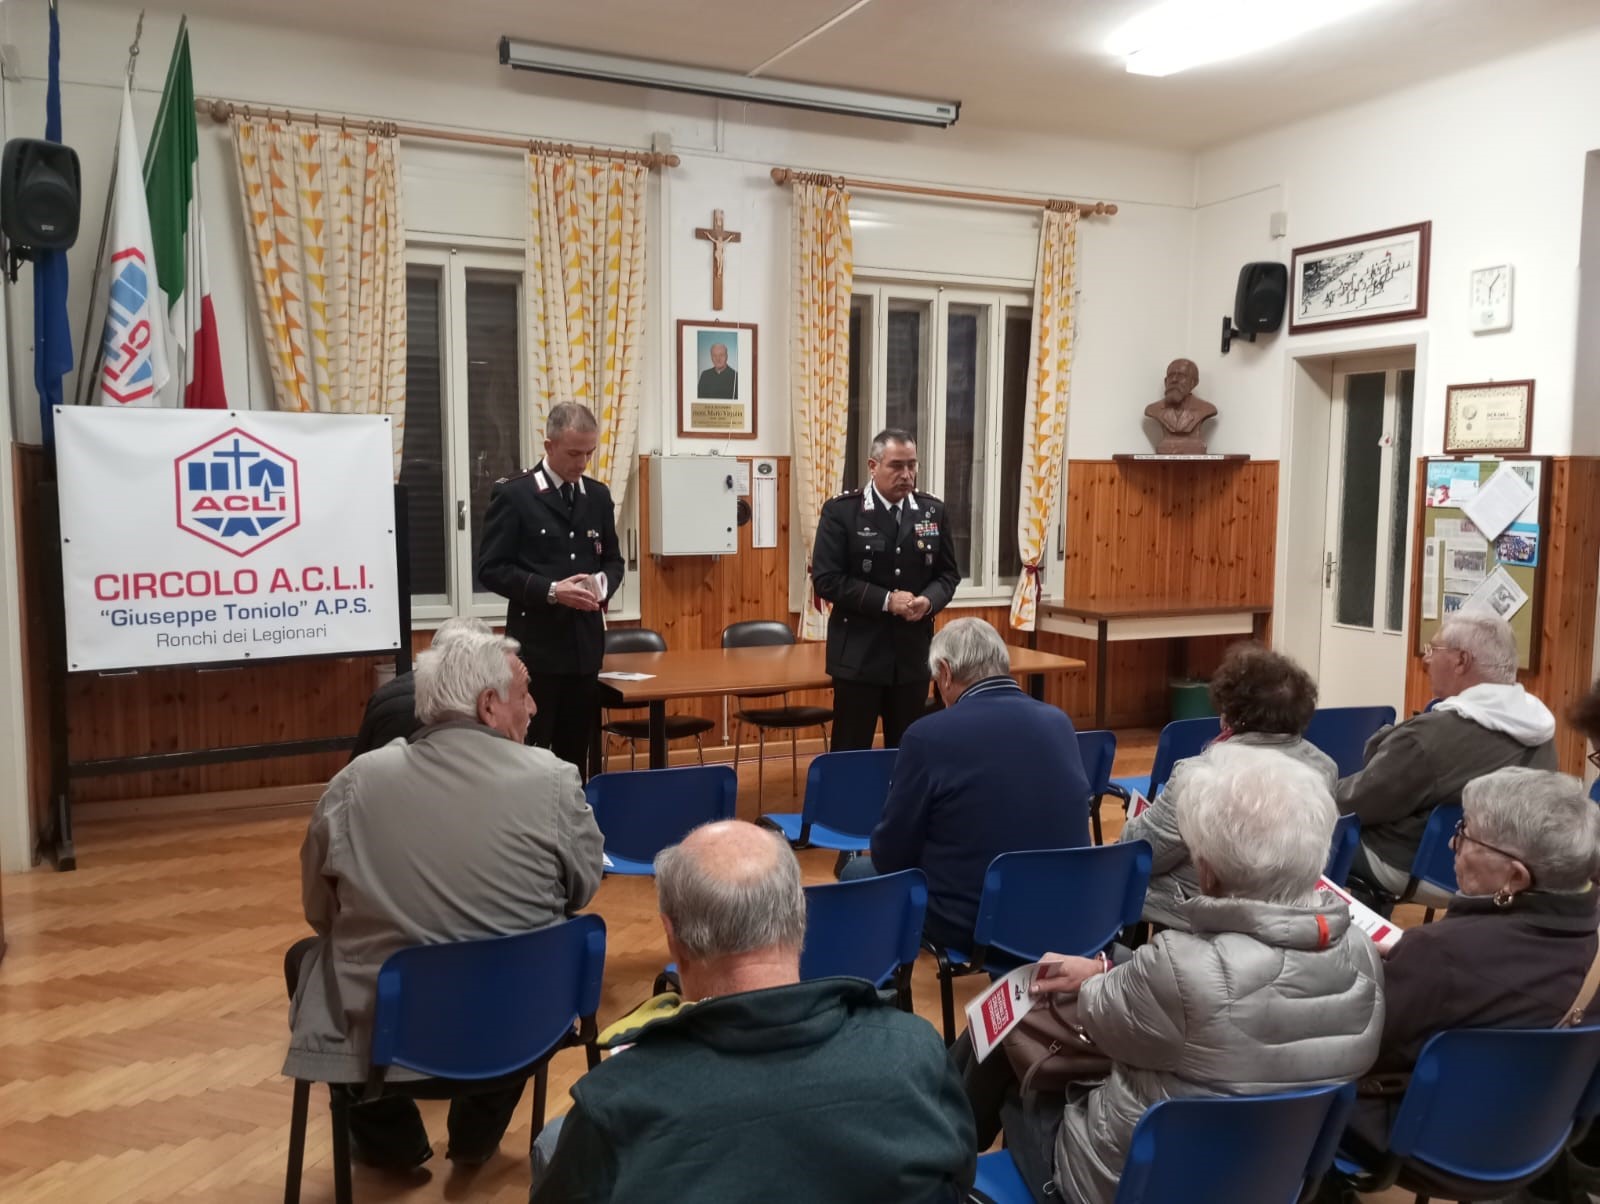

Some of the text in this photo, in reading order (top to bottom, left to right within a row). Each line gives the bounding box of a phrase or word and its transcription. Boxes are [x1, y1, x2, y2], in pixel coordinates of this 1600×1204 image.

[191, 495, 286, 512] ACLI
[94, 565, 374, 601] CIRCOLO A.C.L.I.
[100, 597, 371, 628] “Giuseppe Toniolo” A.P.S.
[156, 623, 327, 648] Ronchi dei Legionari
